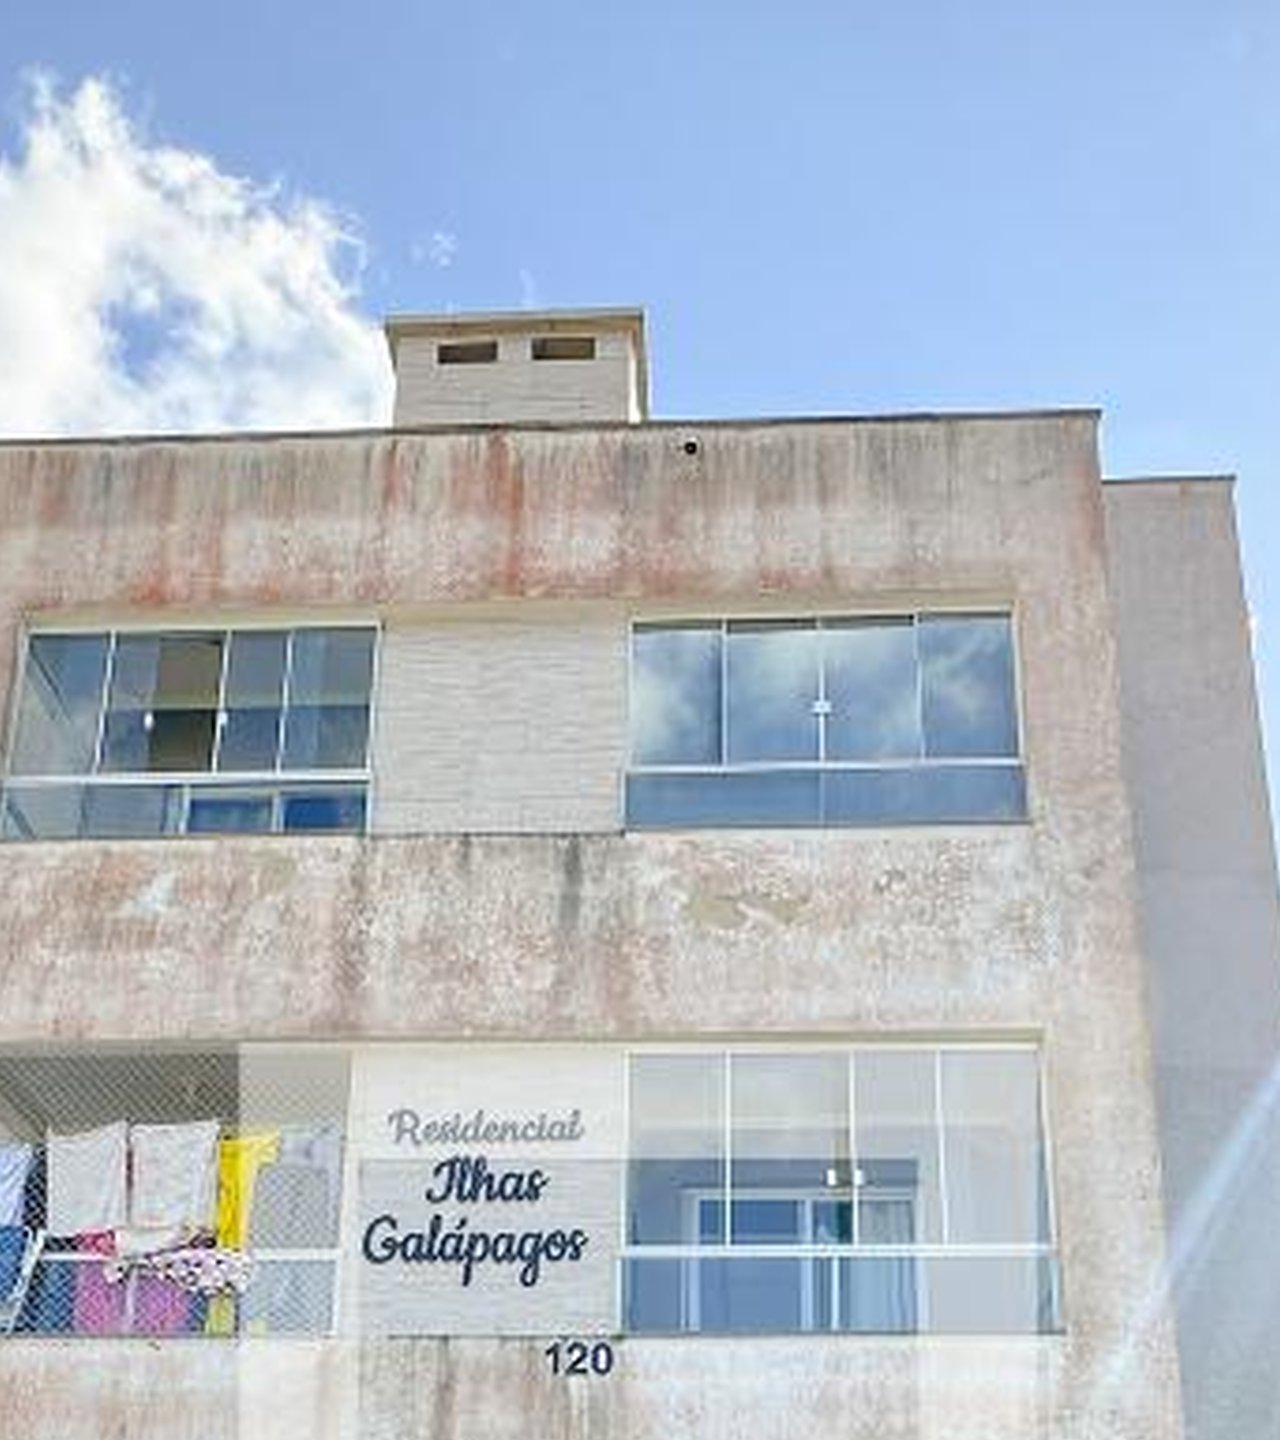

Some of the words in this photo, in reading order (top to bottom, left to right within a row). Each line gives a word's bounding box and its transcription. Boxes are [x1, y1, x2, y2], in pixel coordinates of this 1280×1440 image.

[388, 1109, 584, 1146] Residencial
[426, 1155, 550, 1204] Ilhas
[362, 1214, 588, 1287] Galápagos
[545, 1342, 613, 1375] 120
